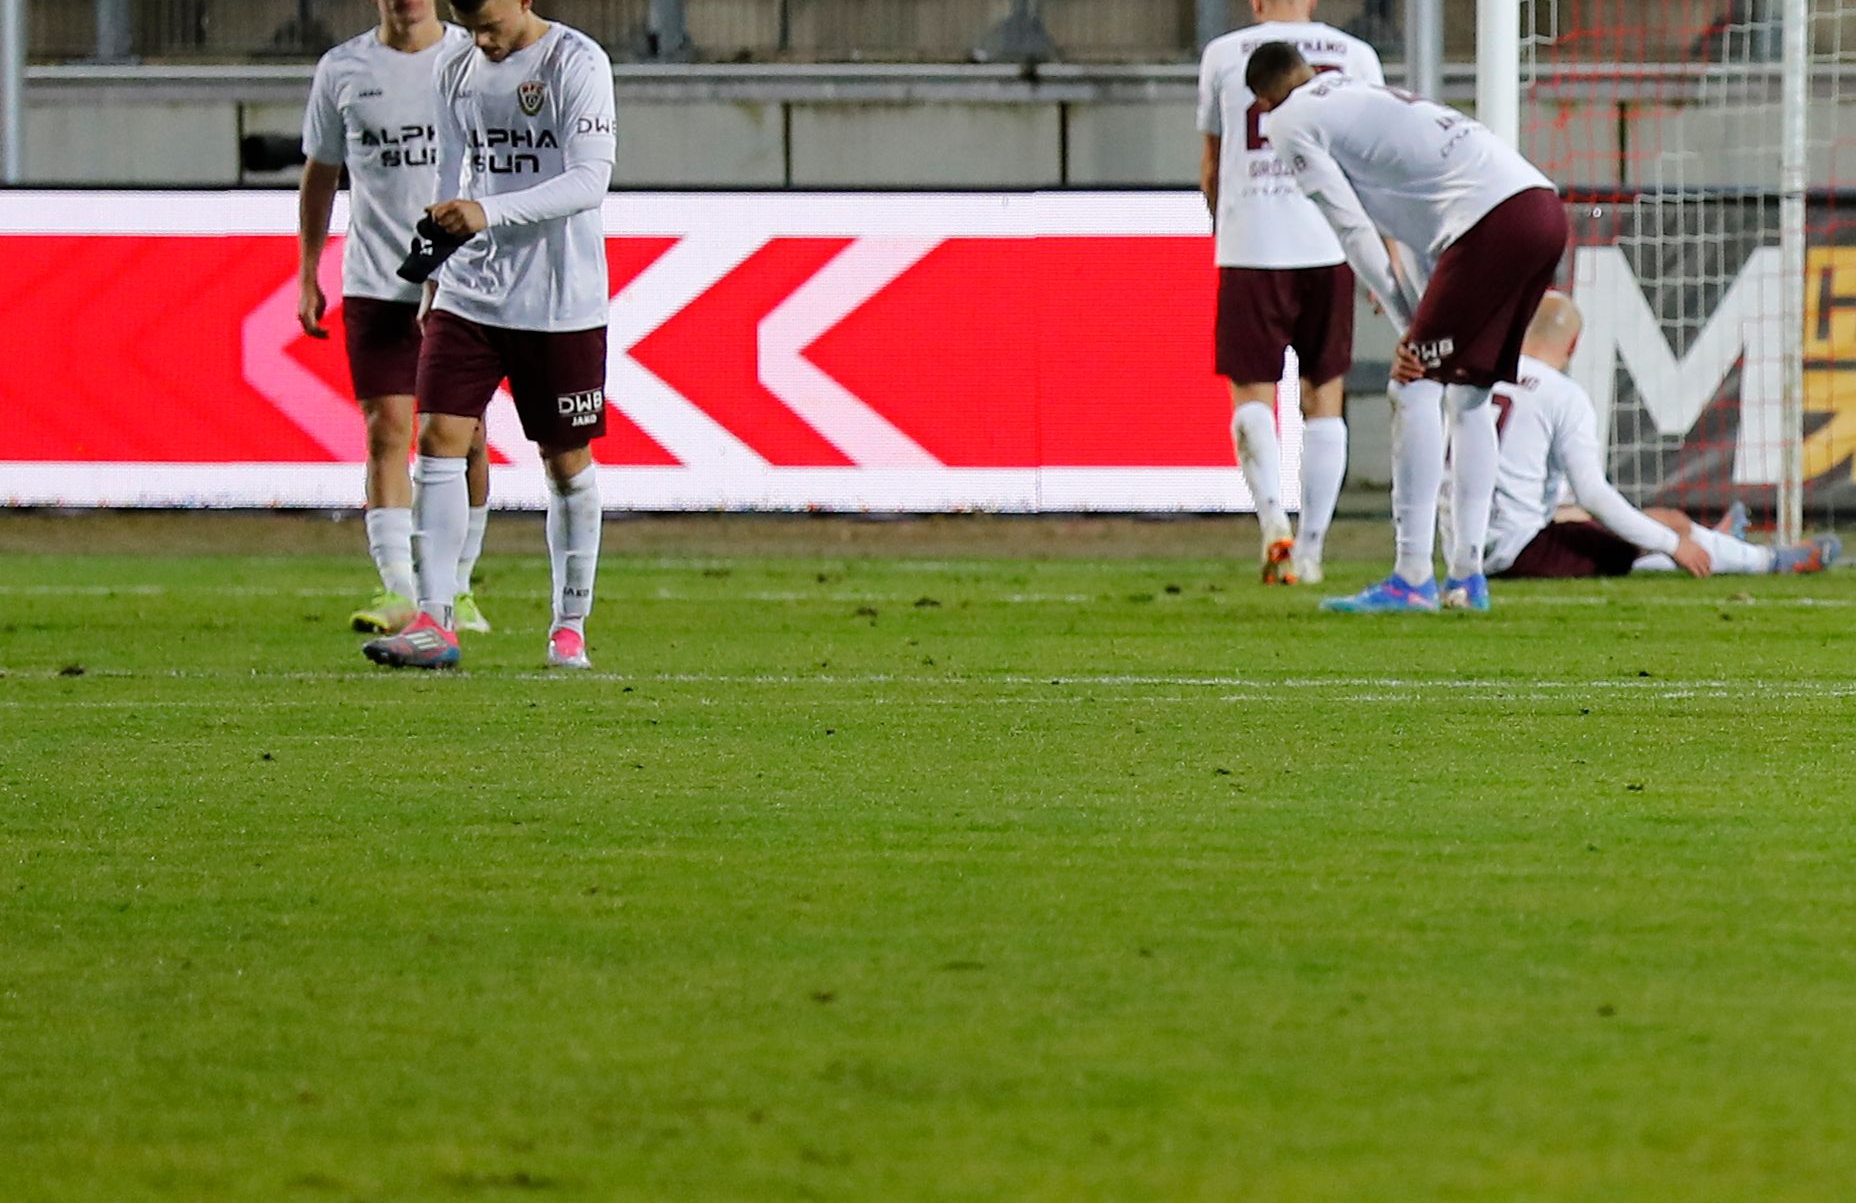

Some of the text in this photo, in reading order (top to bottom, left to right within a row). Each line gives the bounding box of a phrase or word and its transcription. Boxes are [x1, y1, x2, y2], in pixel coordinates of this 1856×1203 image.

[470, 128, 559, 149] LPHA
[558, 391, 604, 415] DWB
[572, 415, 598, 428] JAKO
